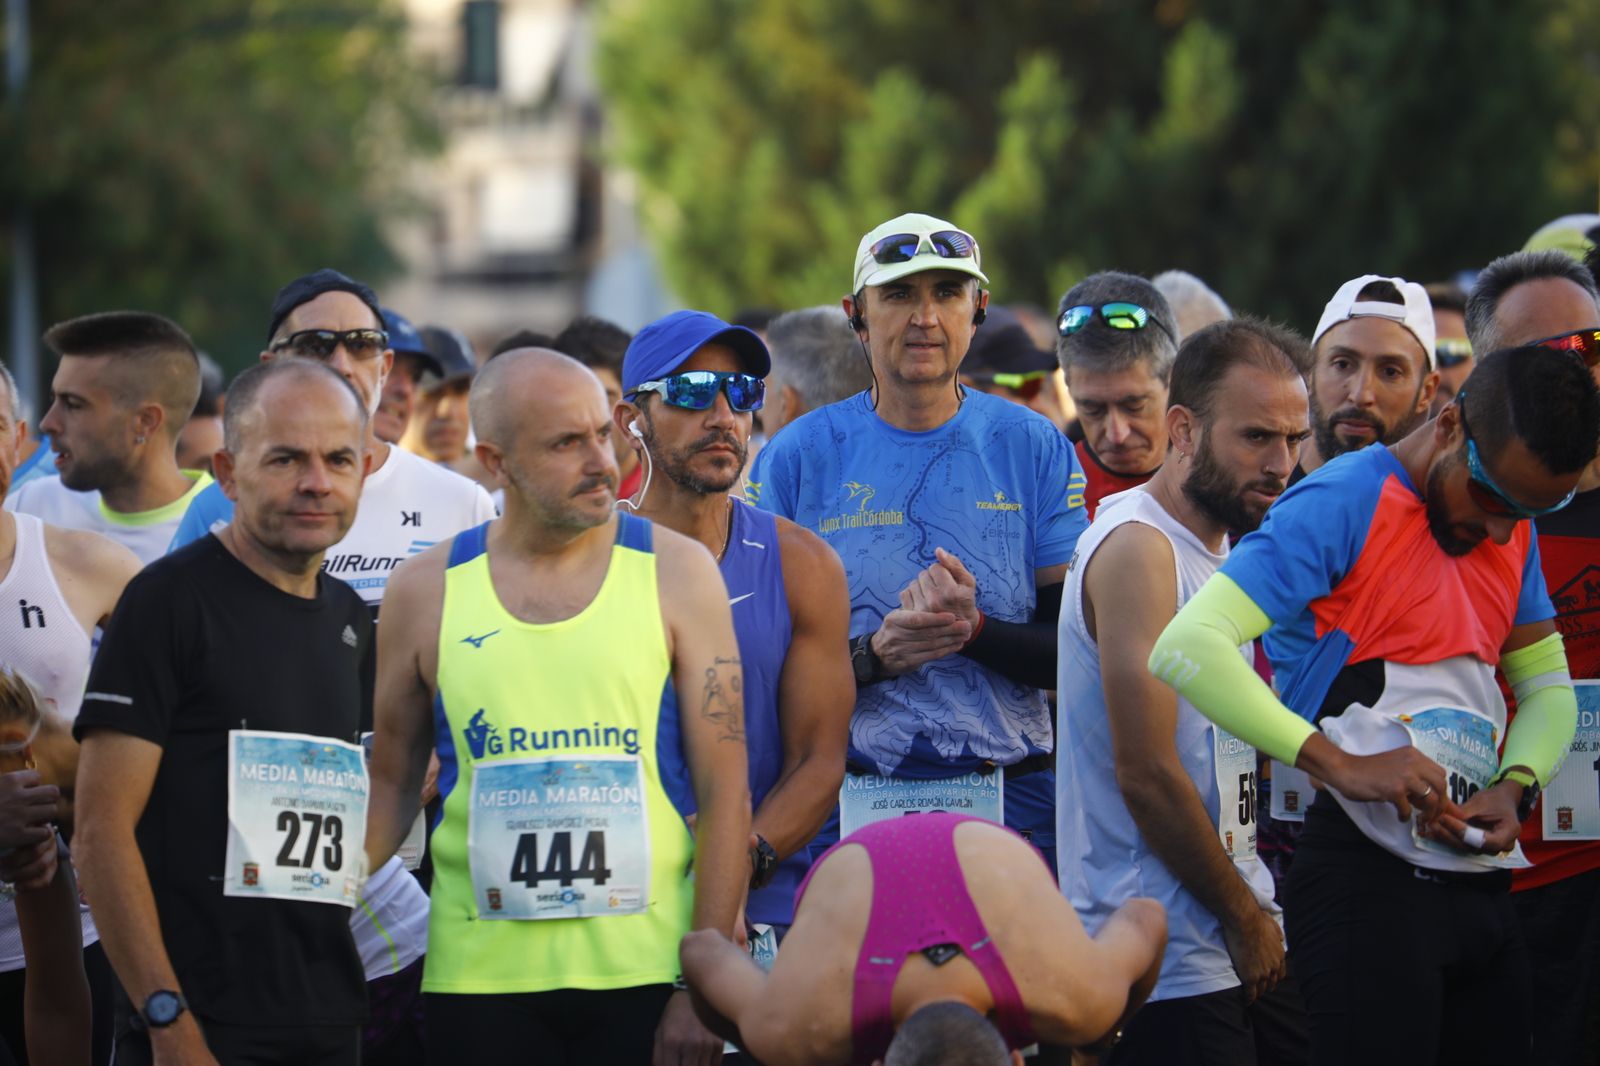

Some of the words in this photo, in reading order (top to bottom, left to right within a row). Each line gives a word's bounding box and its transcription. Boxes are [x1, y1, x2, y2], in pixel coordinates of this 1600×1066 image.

[819, 516, 840, 534] Lynx
[509, 722, 642, 755] Running
[239, 763, 299, 783] MEDIA
[479, 788, 539, 807] MEDIA
[546, 781, 639, 804] MARATÓN
[889, 799, 917, 809] CARLOS
[961, 787, 978, 798] DEL
[276, 811, 342, 872] 273
[510, 830, 612, 888] 444
